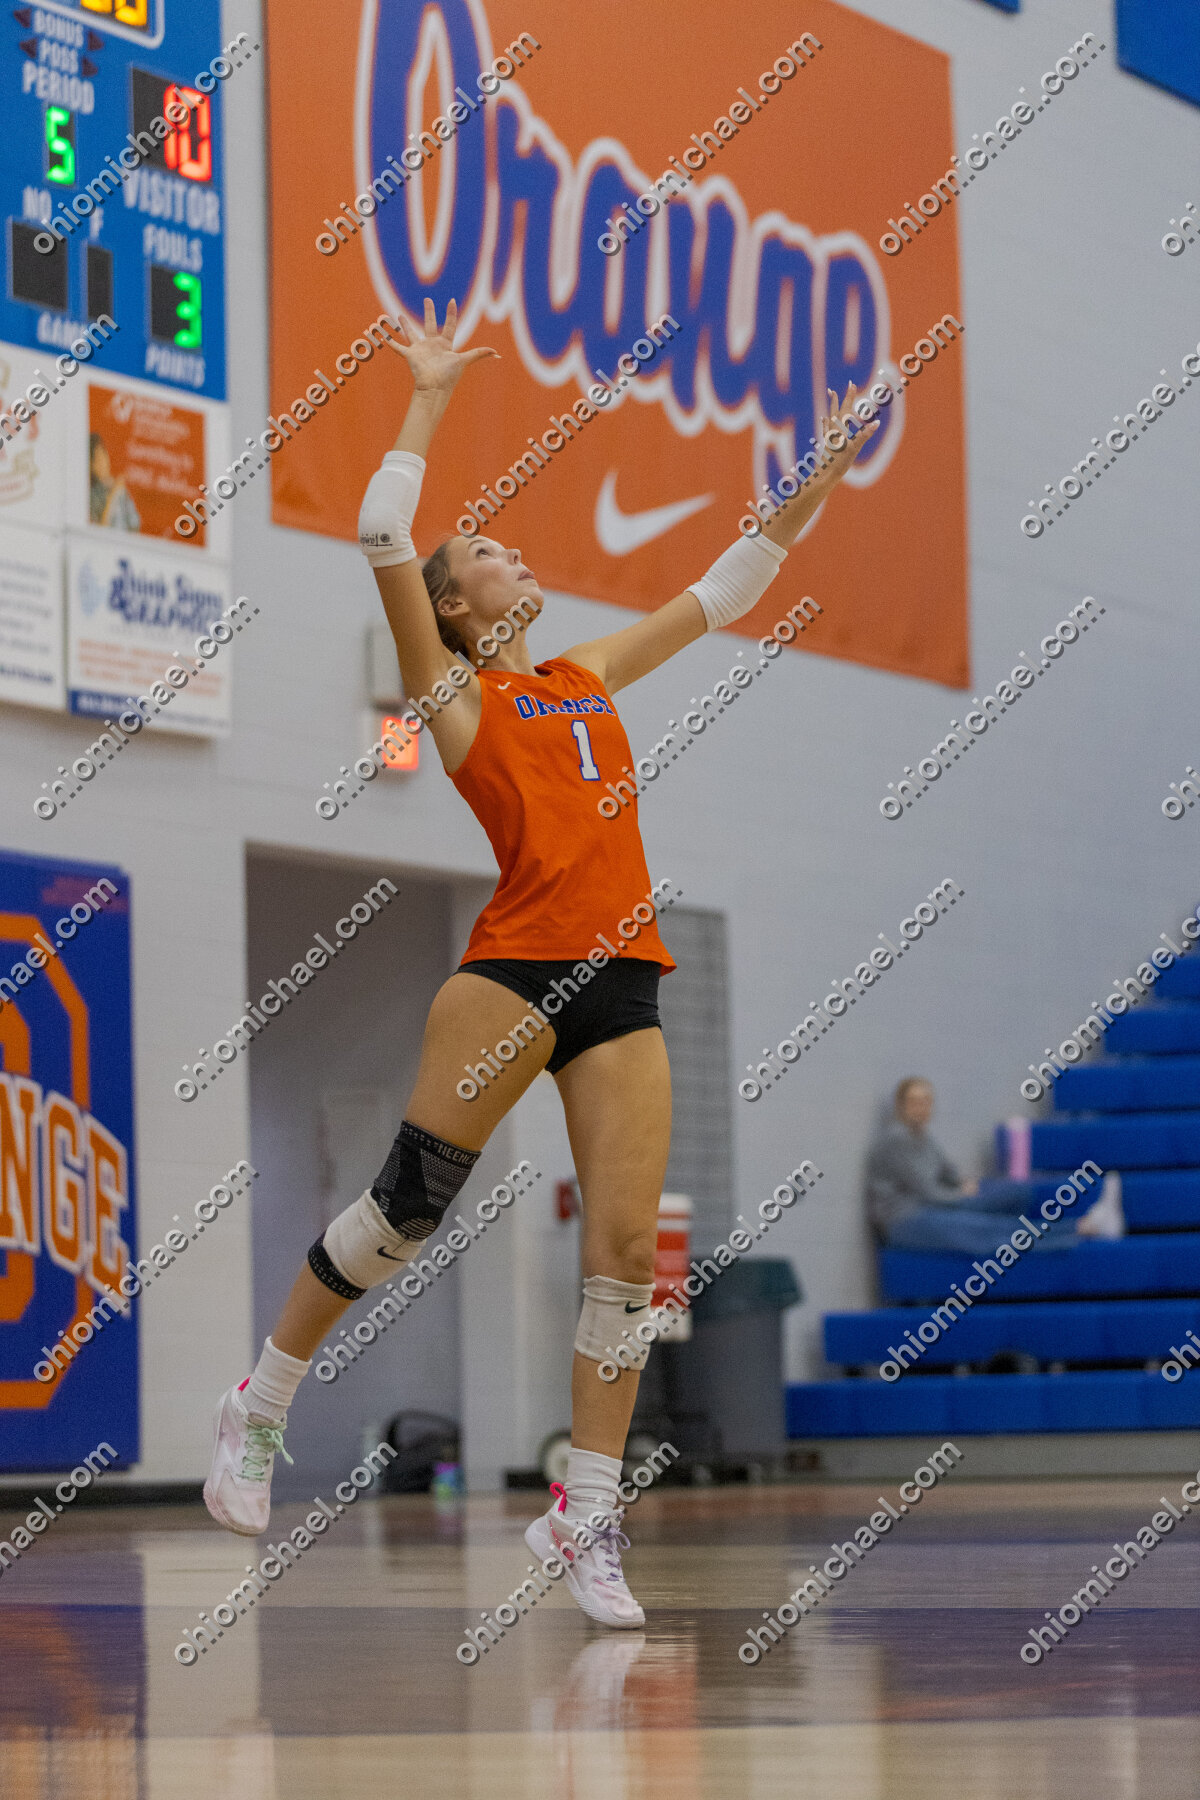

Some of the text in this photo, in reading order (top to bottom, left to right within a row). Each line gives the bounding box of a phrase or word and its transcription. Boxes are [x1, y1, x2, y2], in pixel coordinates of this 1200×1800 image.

[22, 60, 95, 115] PERIOD
[45, 105, 76, 185] 5
[121, 166, 220, 236] VISITOR
[142, 222, 203, 272] FOULS
[354, 0, 905, 542] Orange
[172, 270, 202, 348] 3
[145, 346, 206, 388] POINTS
[570, 719, 601, 781] 1
